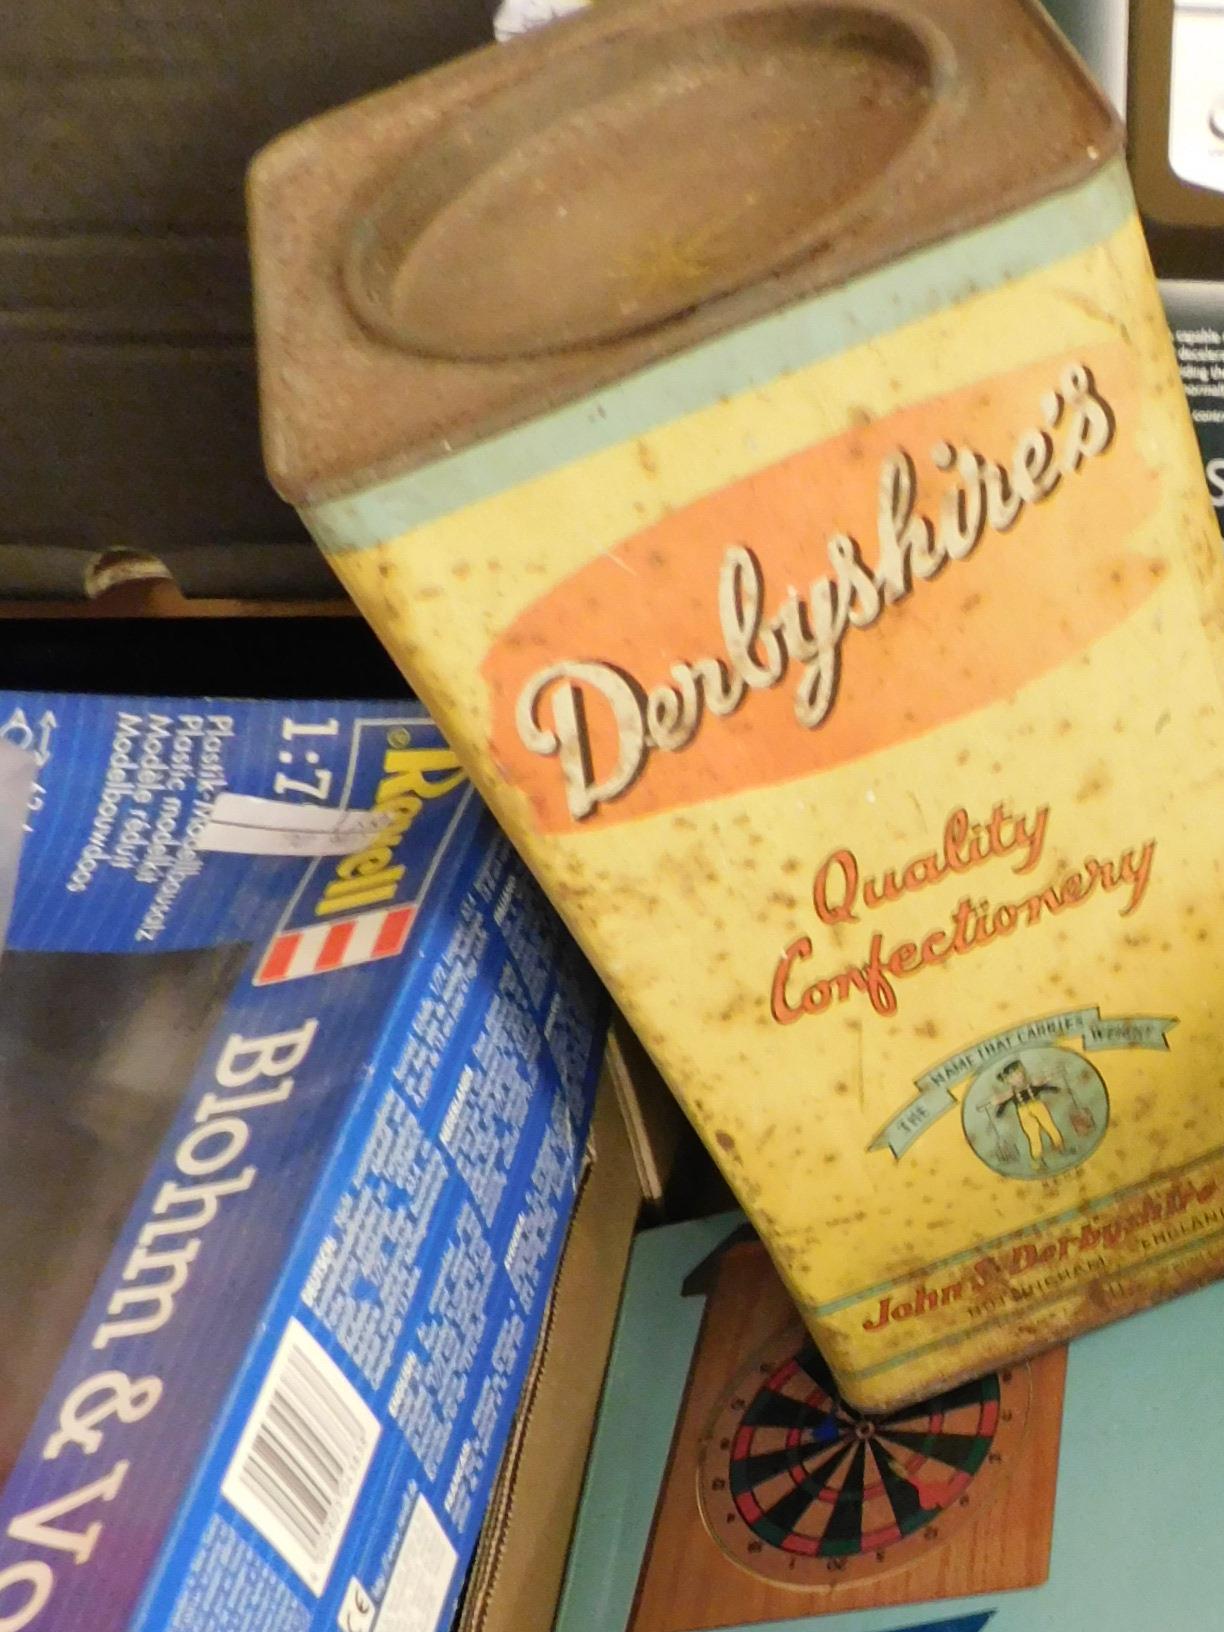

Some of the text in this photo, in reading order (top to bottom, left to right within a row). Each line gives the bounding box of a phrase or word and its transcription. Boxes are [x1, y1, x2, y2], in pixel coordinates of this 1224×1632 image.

[515, 360, 1117, 823] Derbyshire's
[166, 713, 205, 792] Plastic
[274, 716, 340, 802] 1:7
[812, 803, 1051, 925] Quality
[770, 838, 1157, 1025] Confectionery
[899, 1105, 930, 1135] THE
[929, 1056, 975, 1088] NAME
[977, 1035, 1012, 1061] THAT
[92, 1017, 318, 1349] Blohm
[43, 1369, 163, 1460] &
